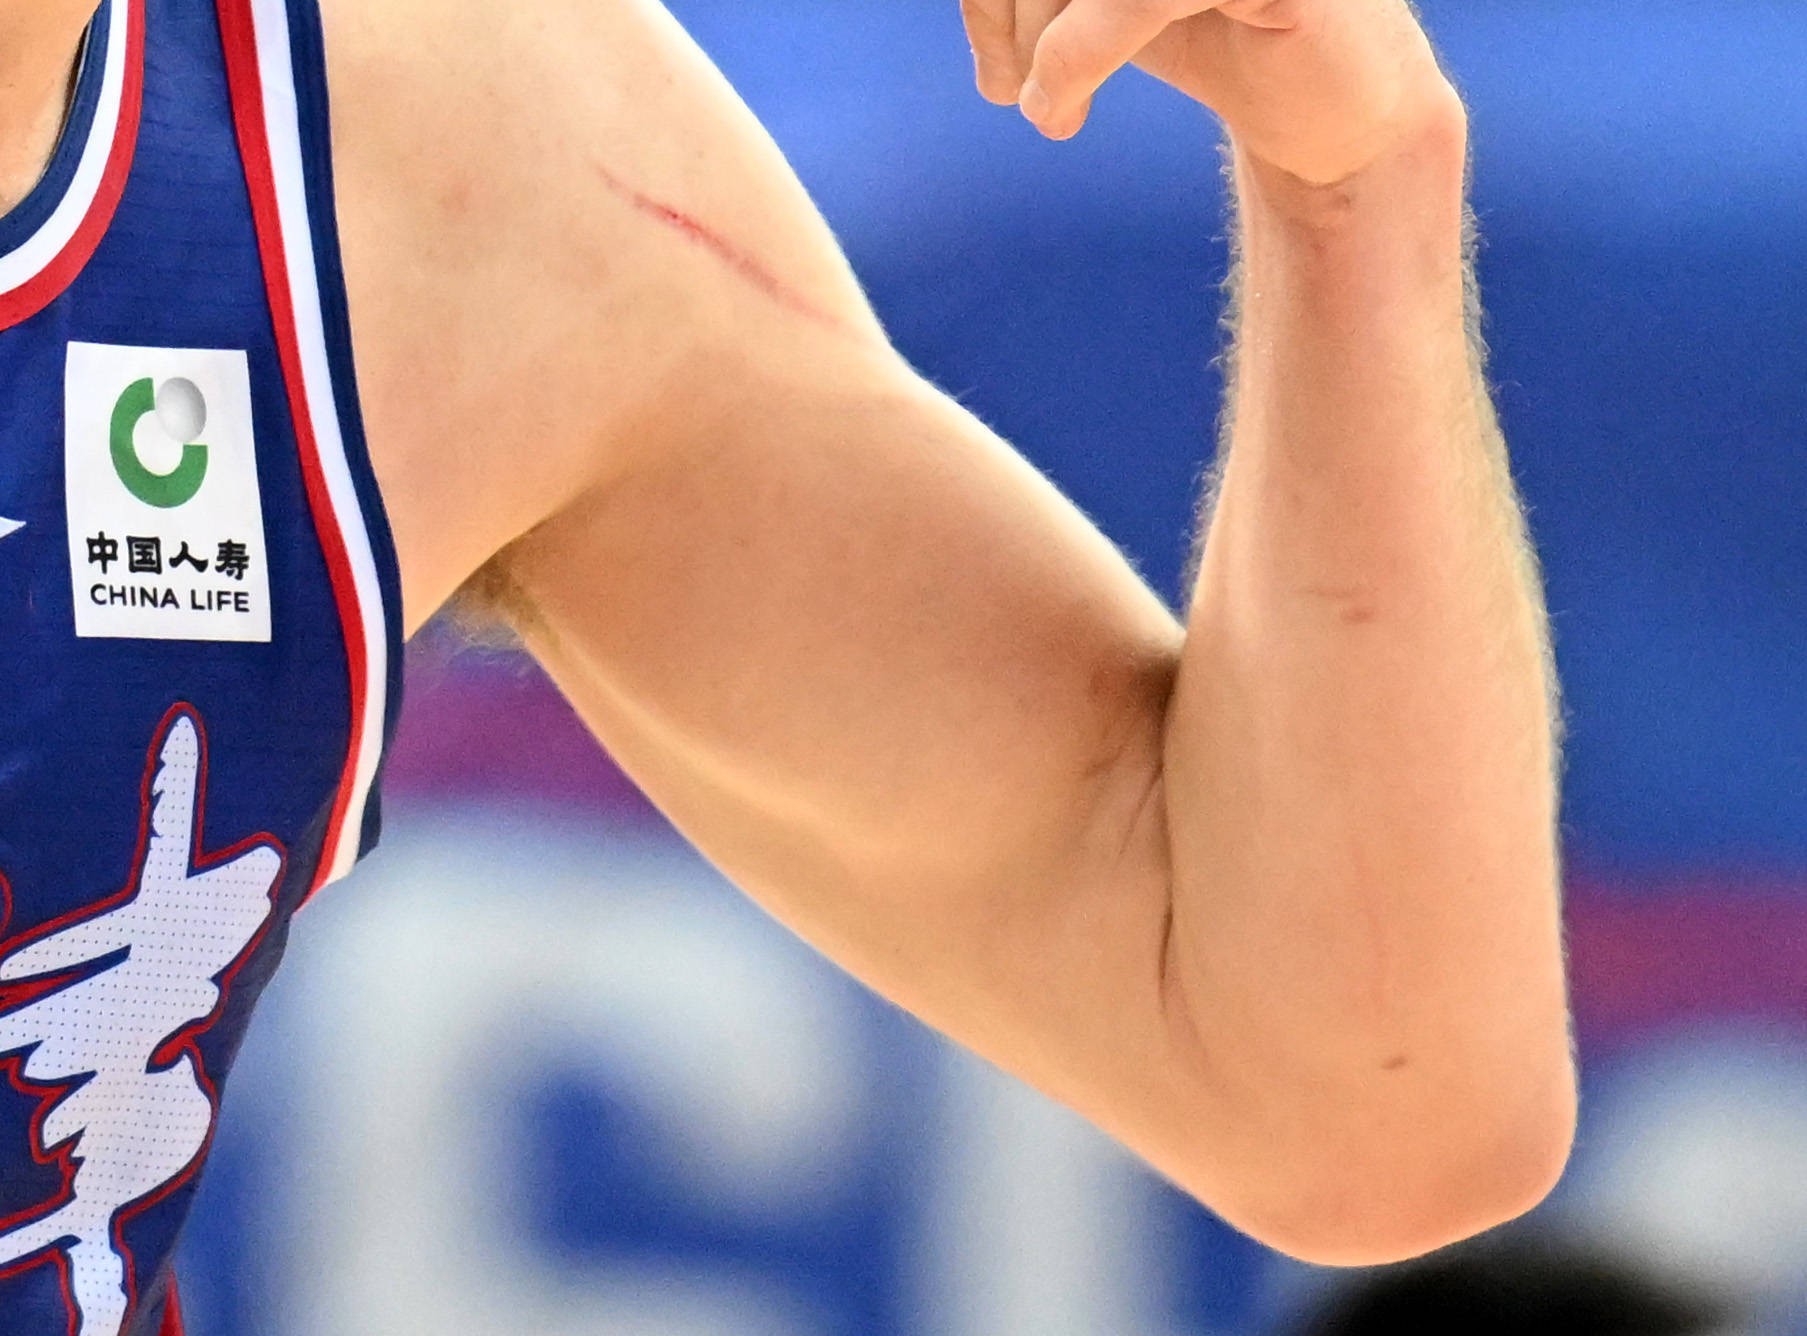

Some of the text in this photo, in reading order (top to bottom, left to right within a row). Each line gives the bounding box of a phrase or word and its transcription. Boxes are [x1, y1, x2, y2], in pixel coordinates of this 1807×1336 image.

[85, 530, 251, 581] 中国人寿
[89, 582, 251, 614] CHINA LIFE
